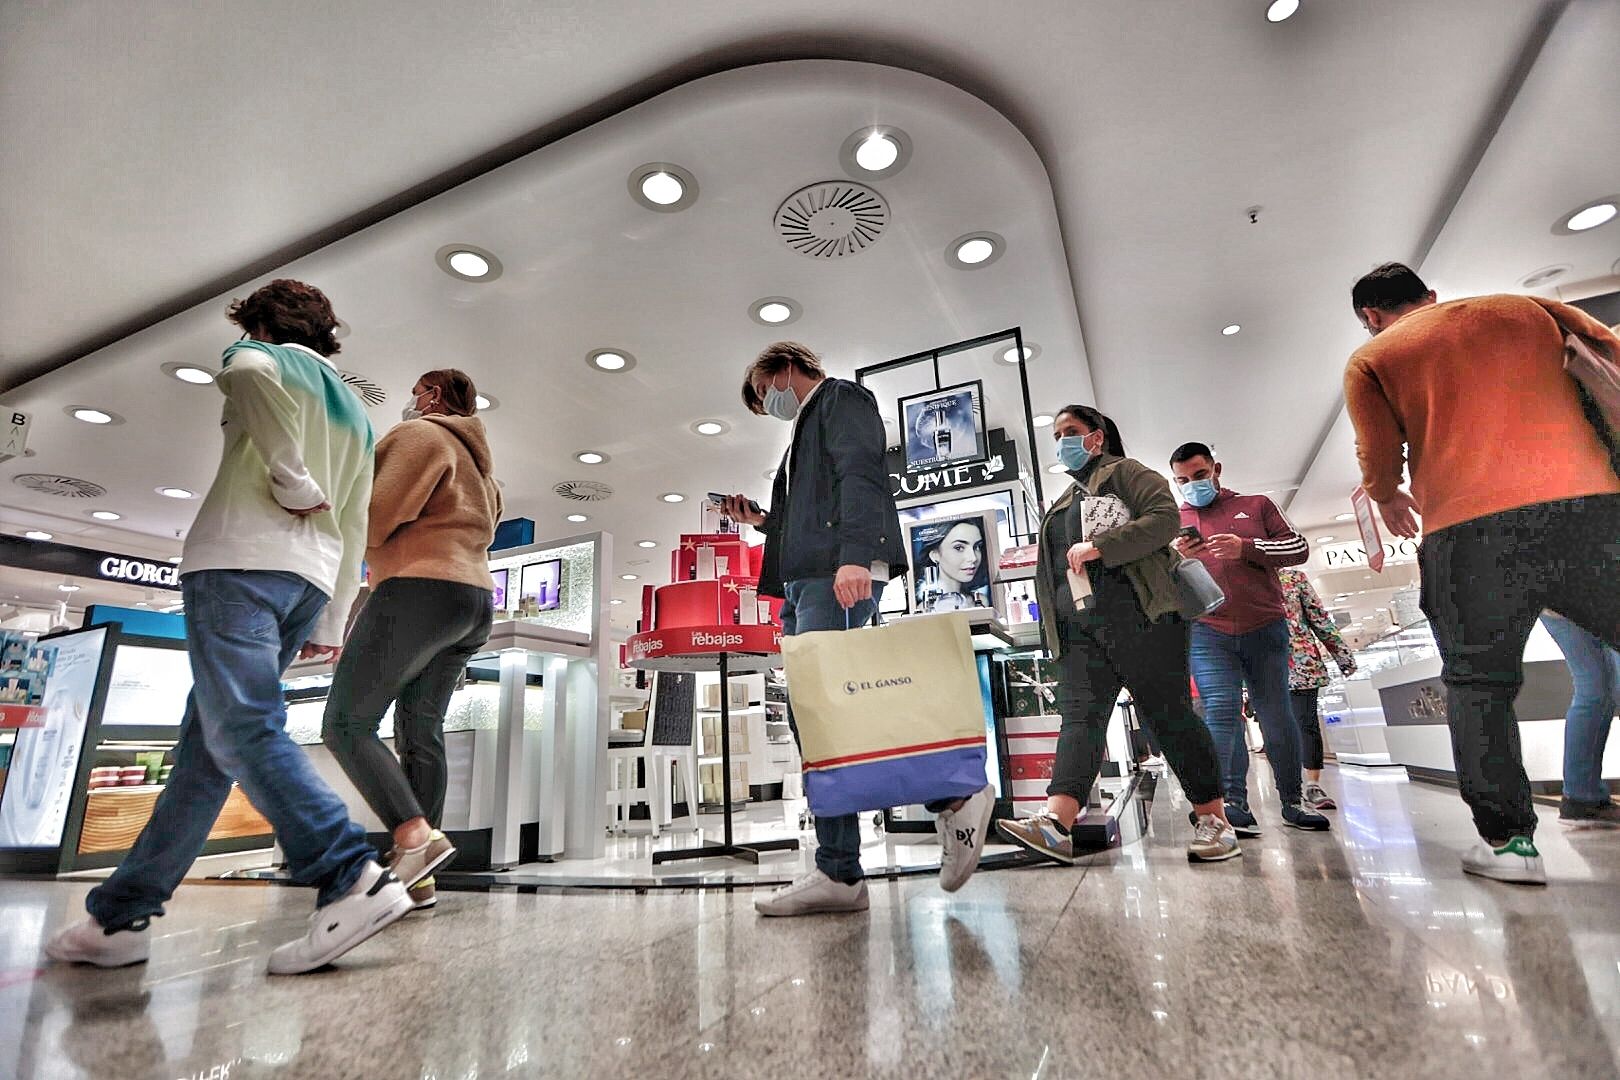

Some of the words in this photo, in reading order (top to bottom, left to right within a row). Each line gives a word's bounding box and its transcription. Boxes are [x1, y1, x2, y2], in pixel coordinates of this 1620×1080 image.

[11, 412, 26, 426] B
[100, 556, 182, 586] GIORGI
[691, 632, 743, 647] rebajas
[860, 682, 872, 690] EL
[875, 676, 912, 689] GANSO
